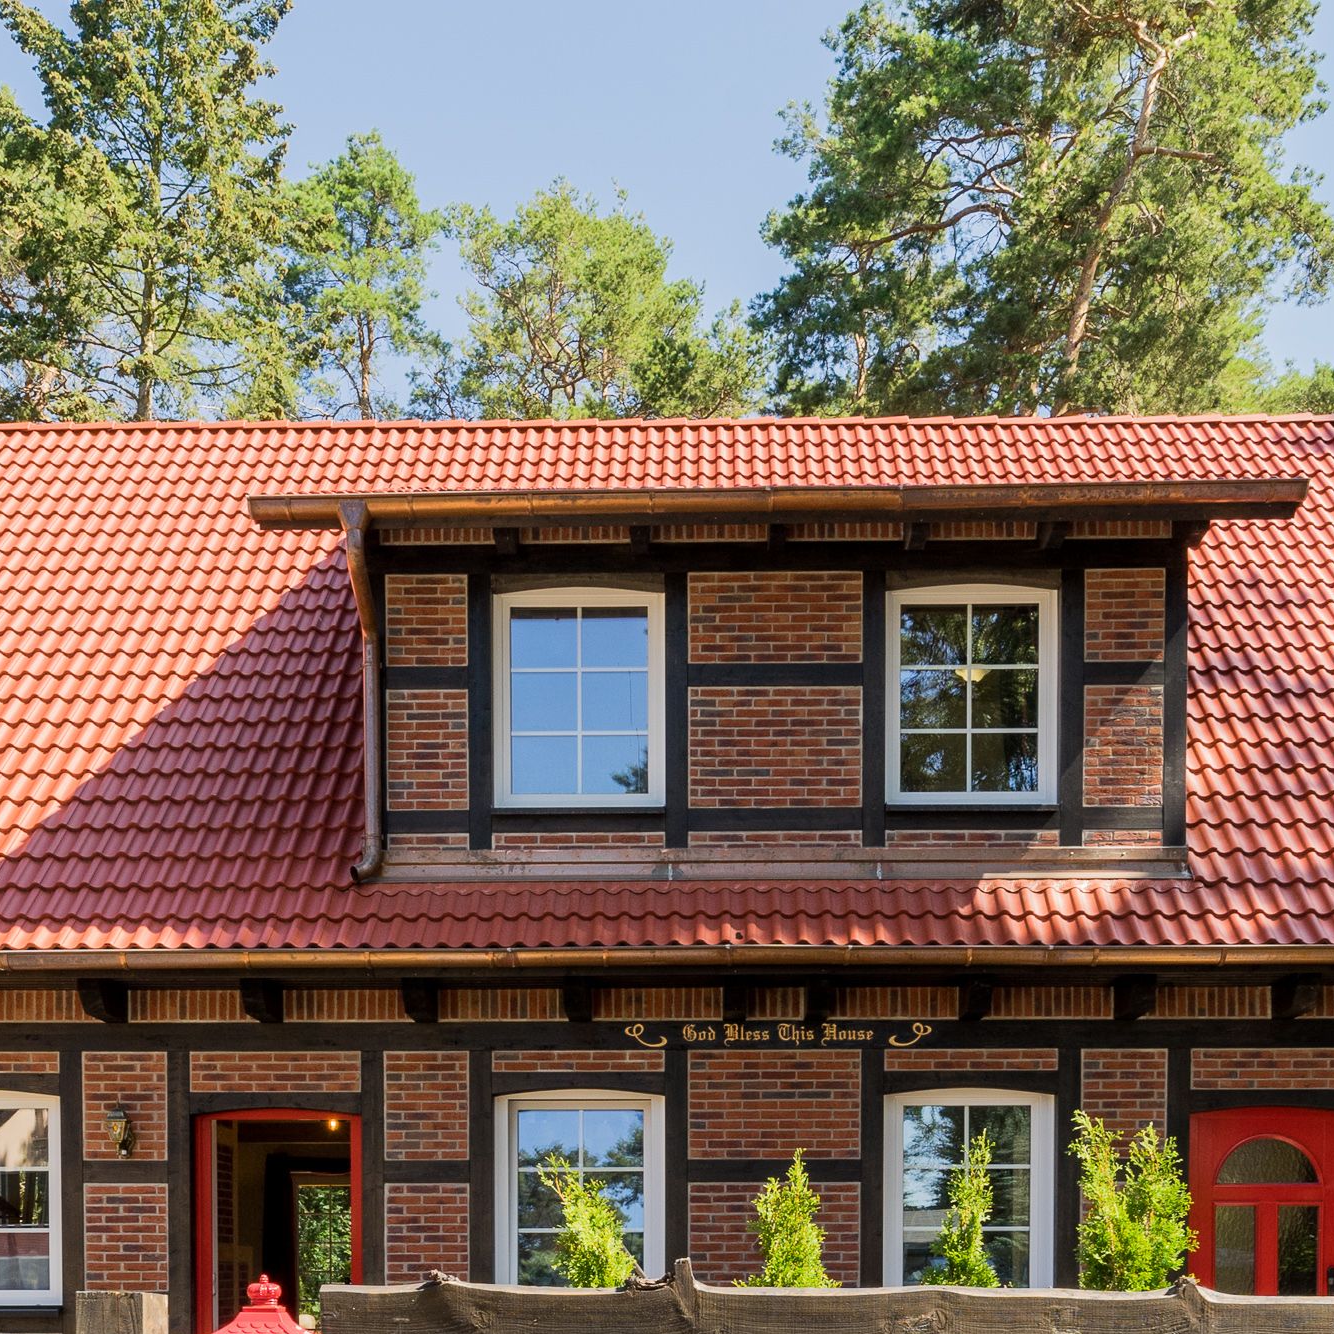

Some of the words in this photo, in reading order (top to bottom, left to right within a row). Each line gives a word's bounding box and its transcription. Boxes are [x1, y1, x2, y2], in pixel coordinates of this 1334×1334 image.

[682, 1023, 716, 1042] God
[723, 1023, 770, 1047] Bless
[777, 1023, 815, 1045] This
[821, 1022, 874, 1046] House
